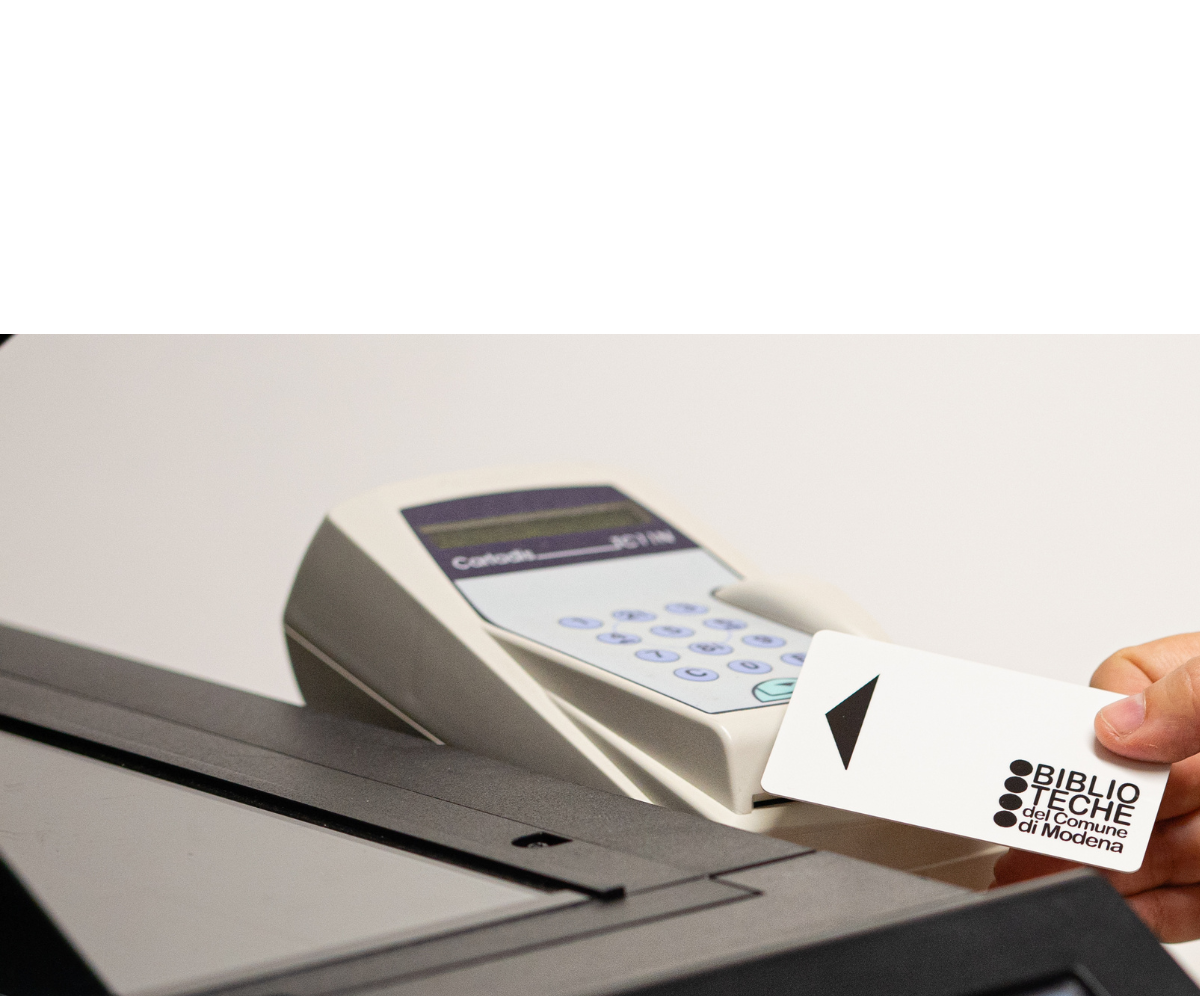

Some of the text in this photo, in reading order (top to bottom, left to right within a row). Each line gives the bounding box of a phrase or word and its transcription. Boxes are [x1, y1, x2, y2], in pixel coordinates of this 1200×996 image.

[1033, 763, 1141, 804] BIBLIO
[1022, 806, 1129, 839] del Comune
[1030, 784, 1136, 826] TECHE
[1018, 819, 1125, 854] di Modena
